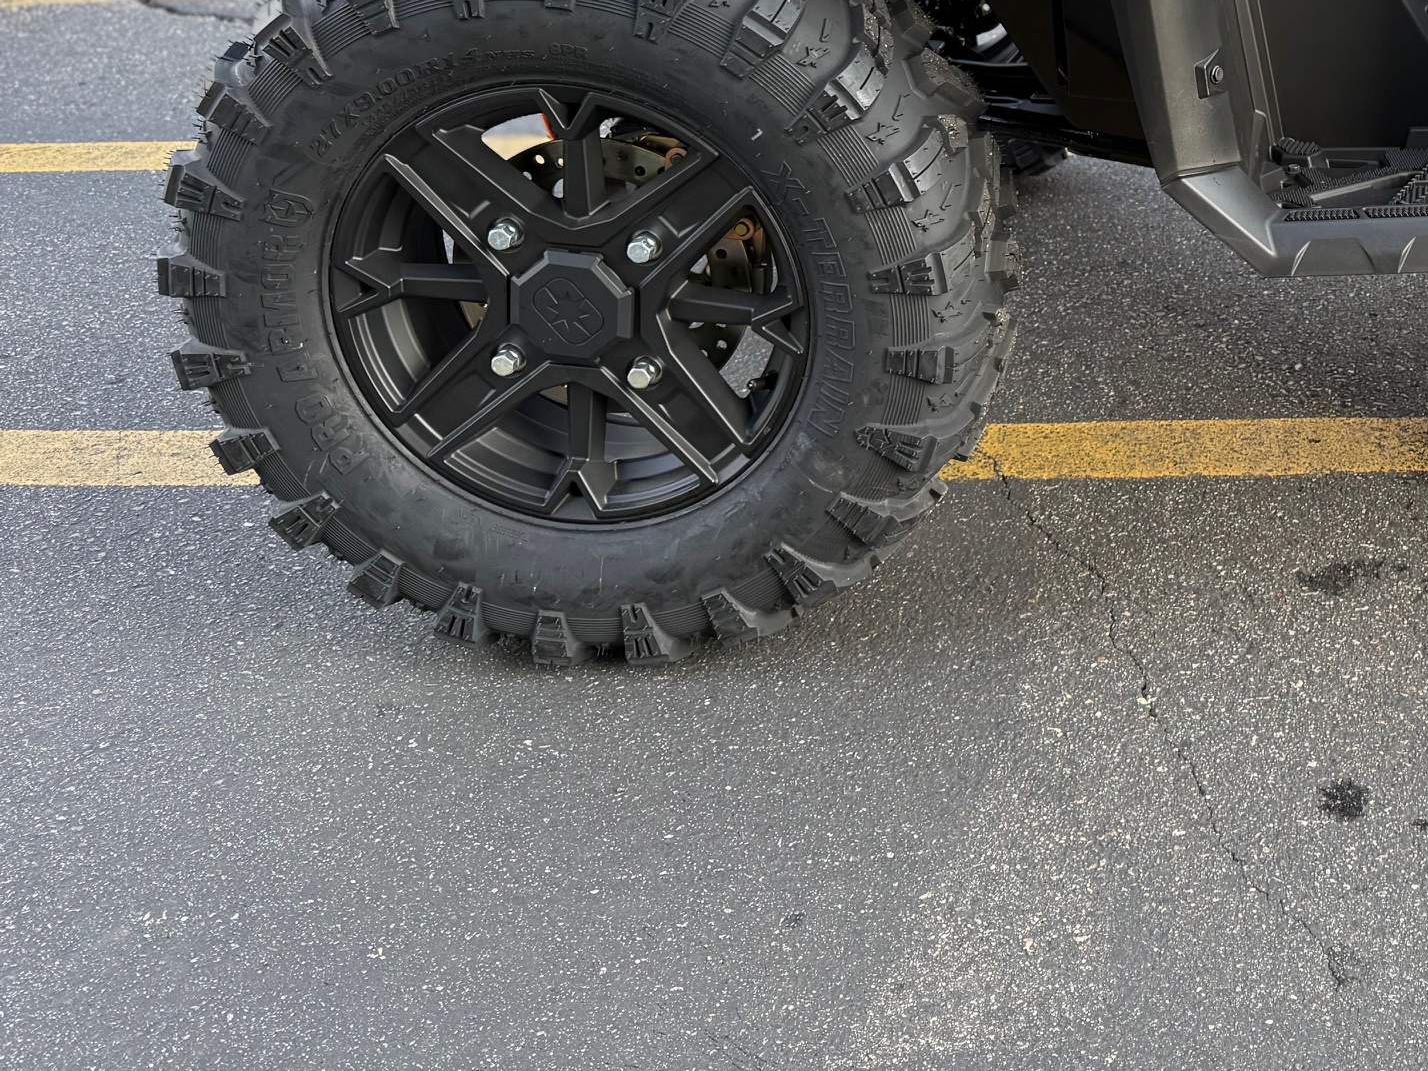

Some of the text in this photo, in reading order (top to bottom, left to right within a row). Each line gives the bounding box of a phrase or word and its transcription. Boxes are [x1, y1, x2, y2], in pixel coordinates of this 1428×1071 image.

[261, 234, 368, 475] PRO ARMOR
[760, 160, 855, 438] X-TERRAIN
